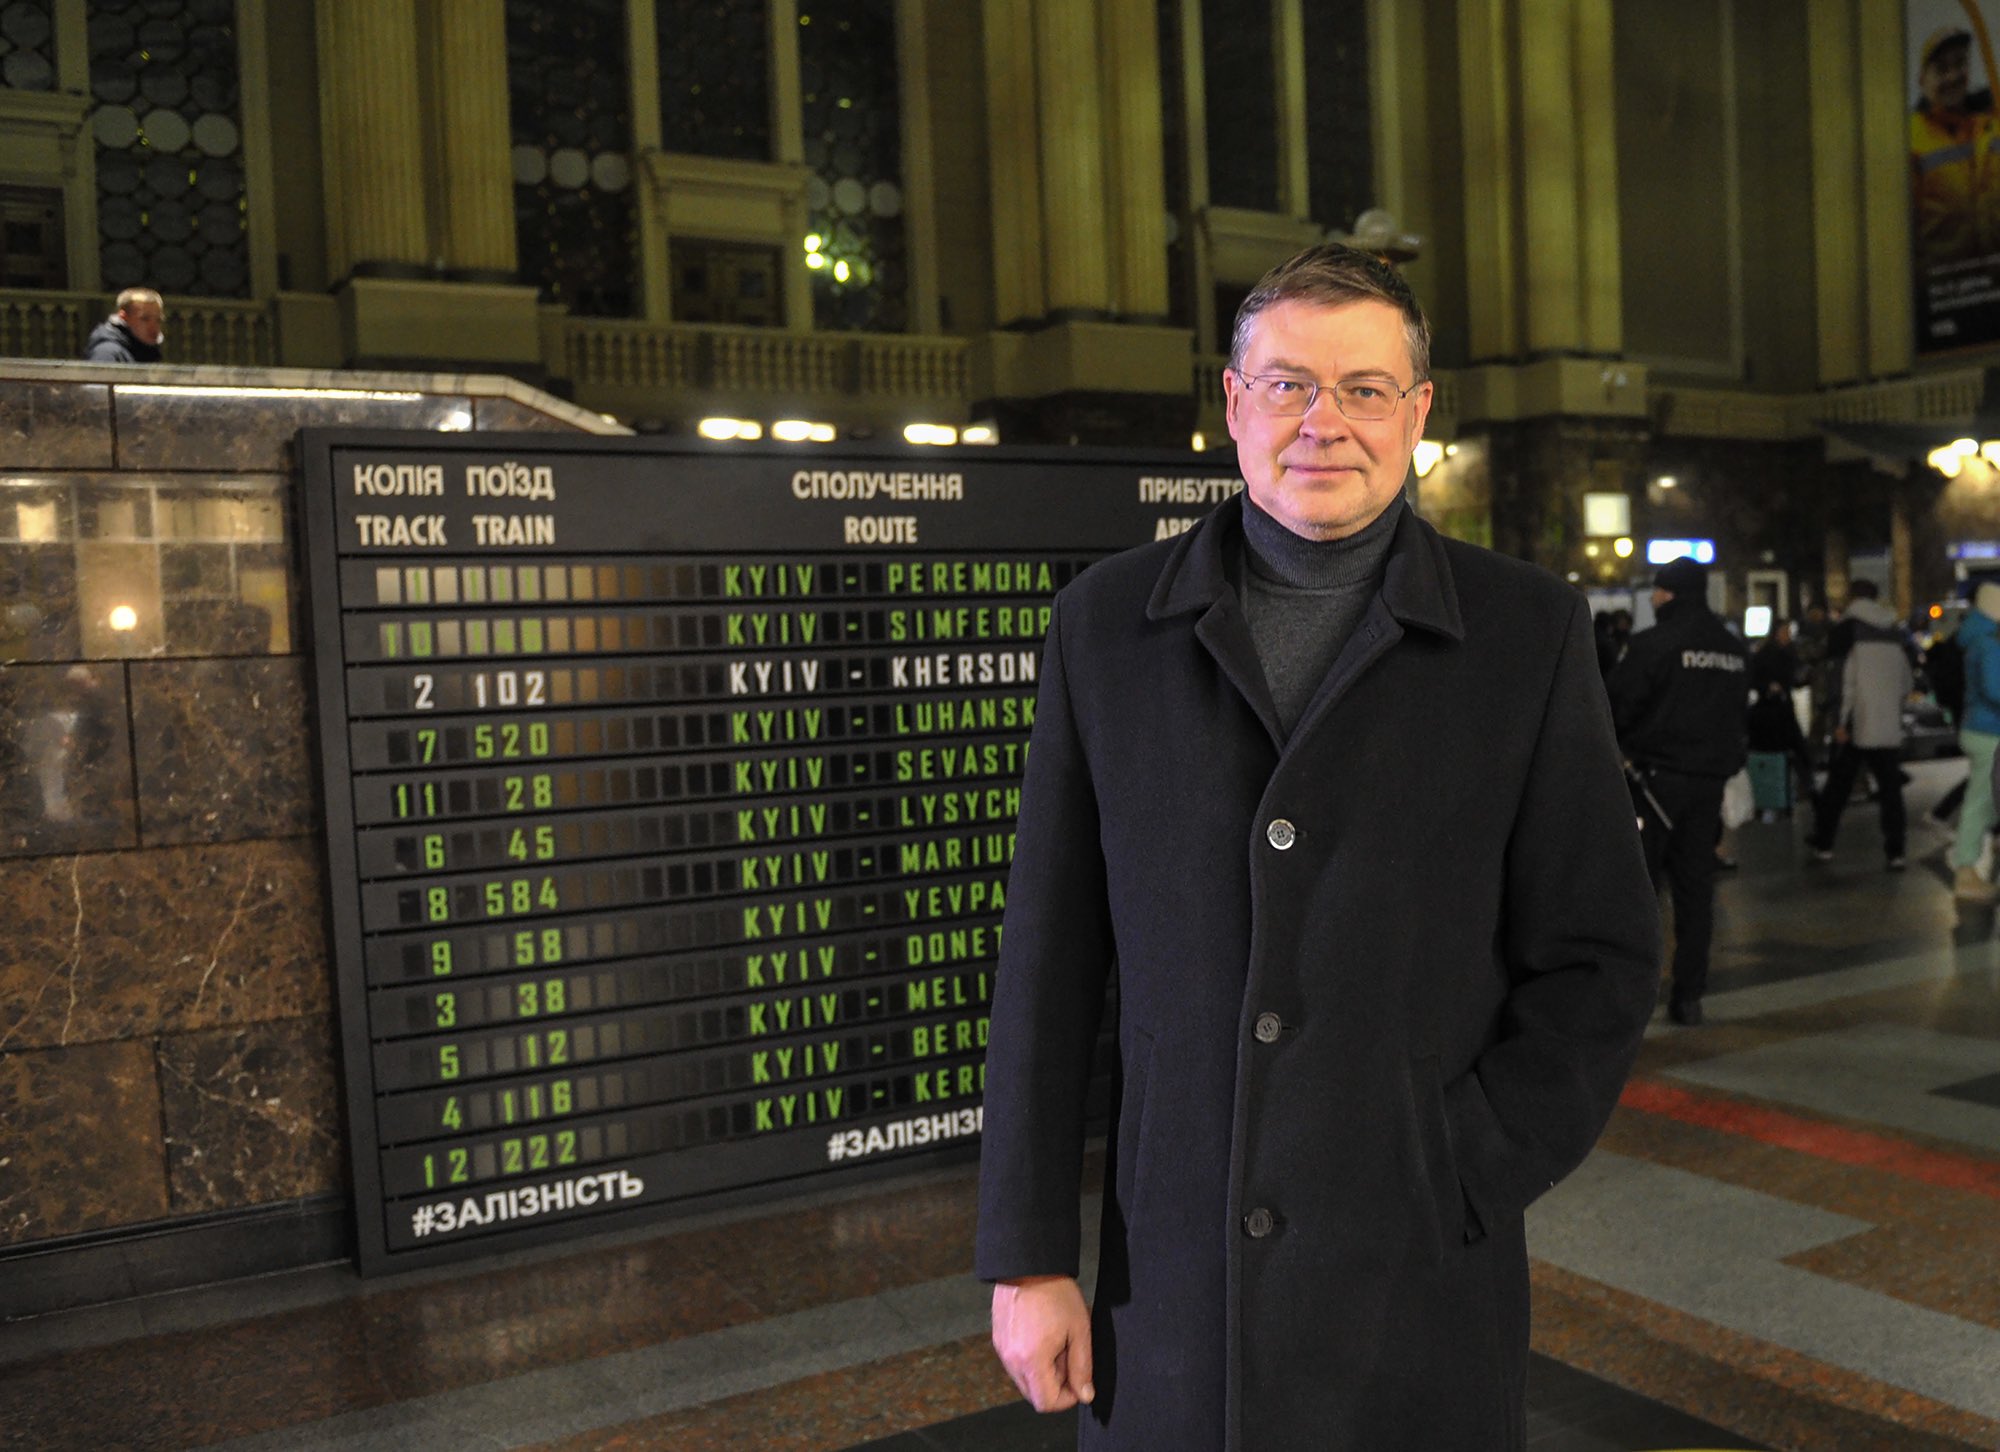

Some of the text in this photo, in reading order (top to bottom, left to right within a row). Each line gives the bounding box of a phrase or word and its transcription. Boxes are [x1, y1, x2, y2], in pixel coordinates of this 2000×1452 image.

[353, 464, 444, 496] КОЛІЯ
[466, 462, 556, 501] ПОЇЗД
[791, 470, 963, 500] СПОЛУЧЕННЯ
[355, 514, 1200, 546] TRACK TRAIN ROUTE ARR
[724, 564, 813, 598] KYIV
[887, 561, 1052, 594] PEREMOHA
[387, 622, 432, 658] 10
[726, 612, 817, 646] KYIV
[890, 606, 1052, 641] SIMFEROP
[413, 674, 434, 710] 2
[474, 670, 546, 708] 102
[730, 660, 818, 695] KYIV
[892, 652, 1035, 687] KHERSON
[417, 728, 437, 764] 7
[474, 721, 549, 760] 520
[731, 707, 821, 745] KYIV
[895, 696, 1036, 735] LUHANSK
[397, 783, 436, 818] 11
[504, 773, 553, 812] 28
[735, 756, 823, 793] KYIV
[424, 833, 446, 870] 6
[507, 825, 556, 862] 45
[736, 803, 826, 842] KYIV
[900, 787, 1021, 827] LYSYCH
[427, 886, 449, 922] 8
[485, 878, 559, 917] 584
[741, 849, 829, 890] KYIV
[431, 939, 453, 976] 9
[514, 928, 562, 966] 58
[742, 898, 832, 939] KYIV
[904, 880, 1006, 920] YEVPA
[435, 992, 457, 1028] 3
[517, 978, 566, 1018] 38
[746, 945, 835, 988] KYIV
[439, 1044, 461, 1080] 5
[526, 1029, 568, 1068] 12
[748, 992, 837, 1035] KYIV
[441, 1096, 463, 1131] 4
[503, 1079, 572, 1124] 116
[751, 1040, 840, 1084] KYIV
[423, 1147, 469, 1189] 12
[502, 1129, 577, 1174] 222
[755, 1087, 843, 1131] KYIV
[412, 1169, 644, 1237] #ЗАЛІЗНІСТЬ
